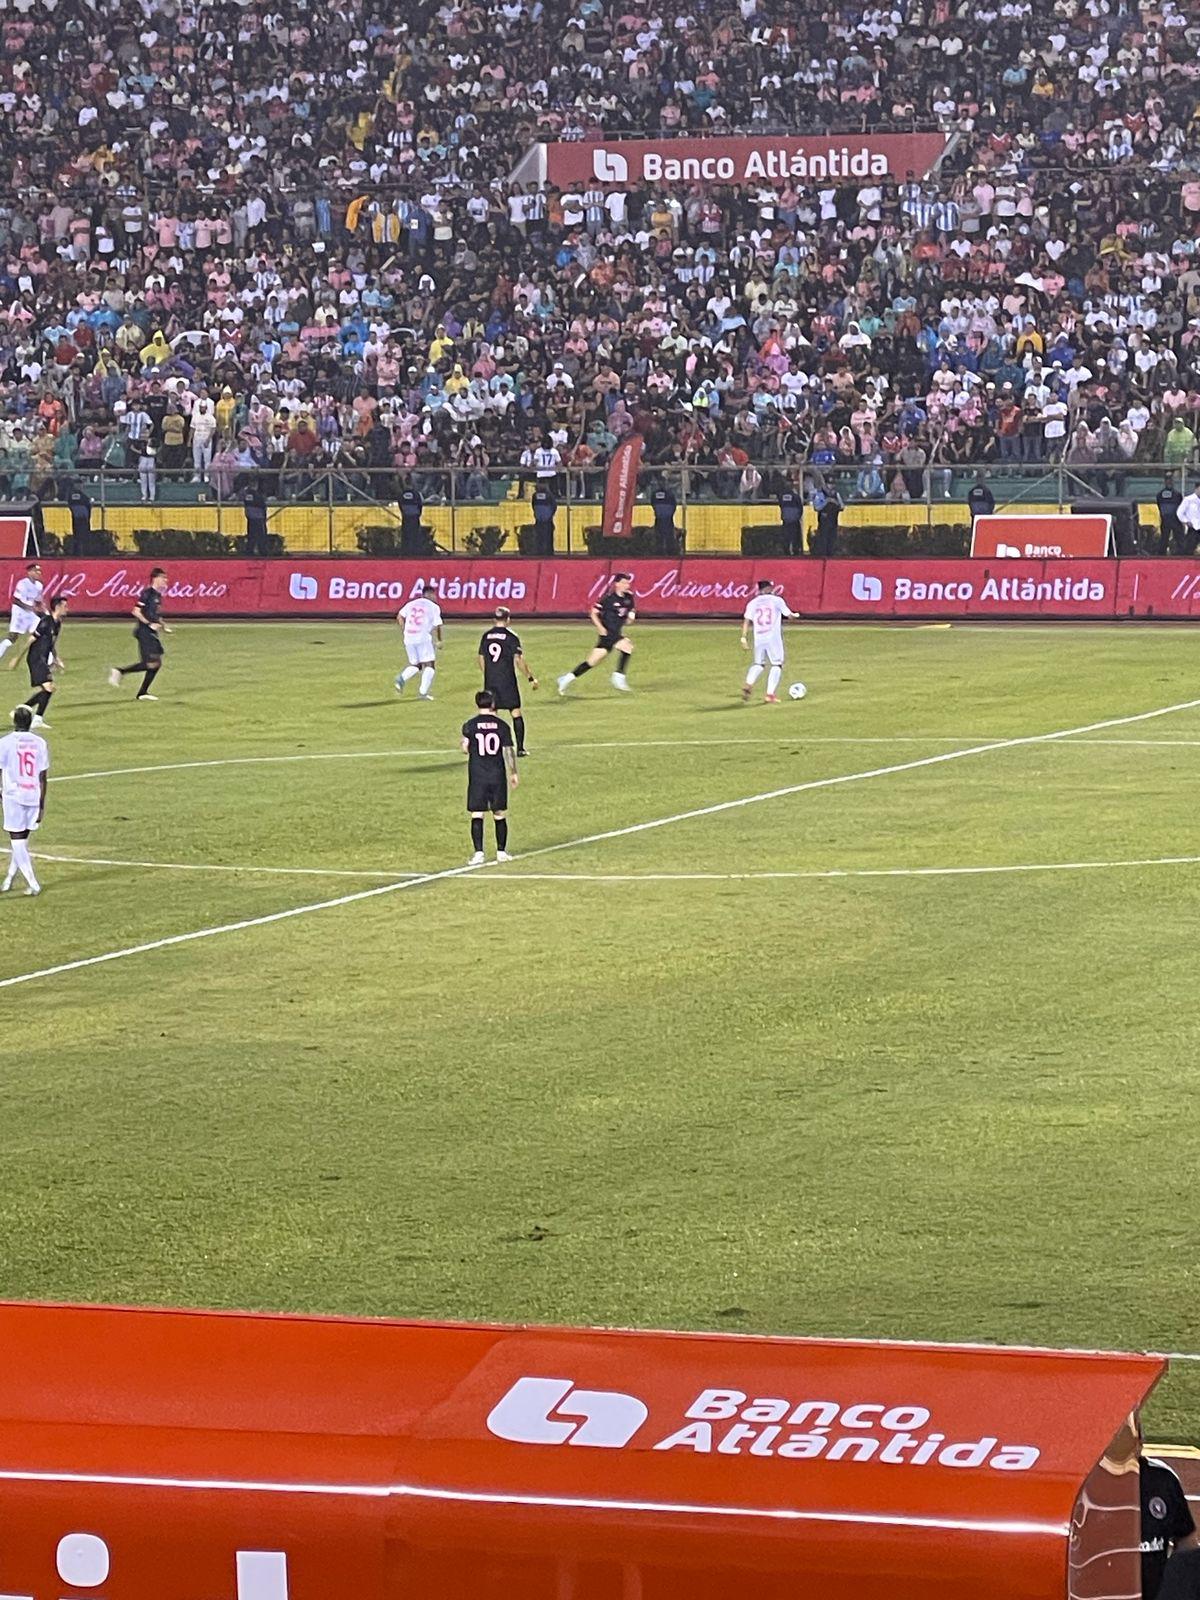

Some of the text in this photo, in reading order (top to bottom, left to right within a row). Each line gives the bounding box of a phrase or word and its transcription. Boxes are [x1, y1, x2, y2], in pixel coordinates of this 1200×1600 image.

[643, 148, 888, 181] Banco Atlántida
[542, 453, 553, 465] 17
[1024, 543, 1062, 556] Banco
[329, 577, 402, 600] Banco
[895, 576, 1105, 601] Banco Atlántida
[755, 607, 773, 626] 23
[488, 642, 502, 663] 9
[475, 732, 500, 756] 10
[16, 751, 36, 777] 16
[684, 1388, 931, 1431] Banco
[652, 1421, 1041, 1471] Atlántida
